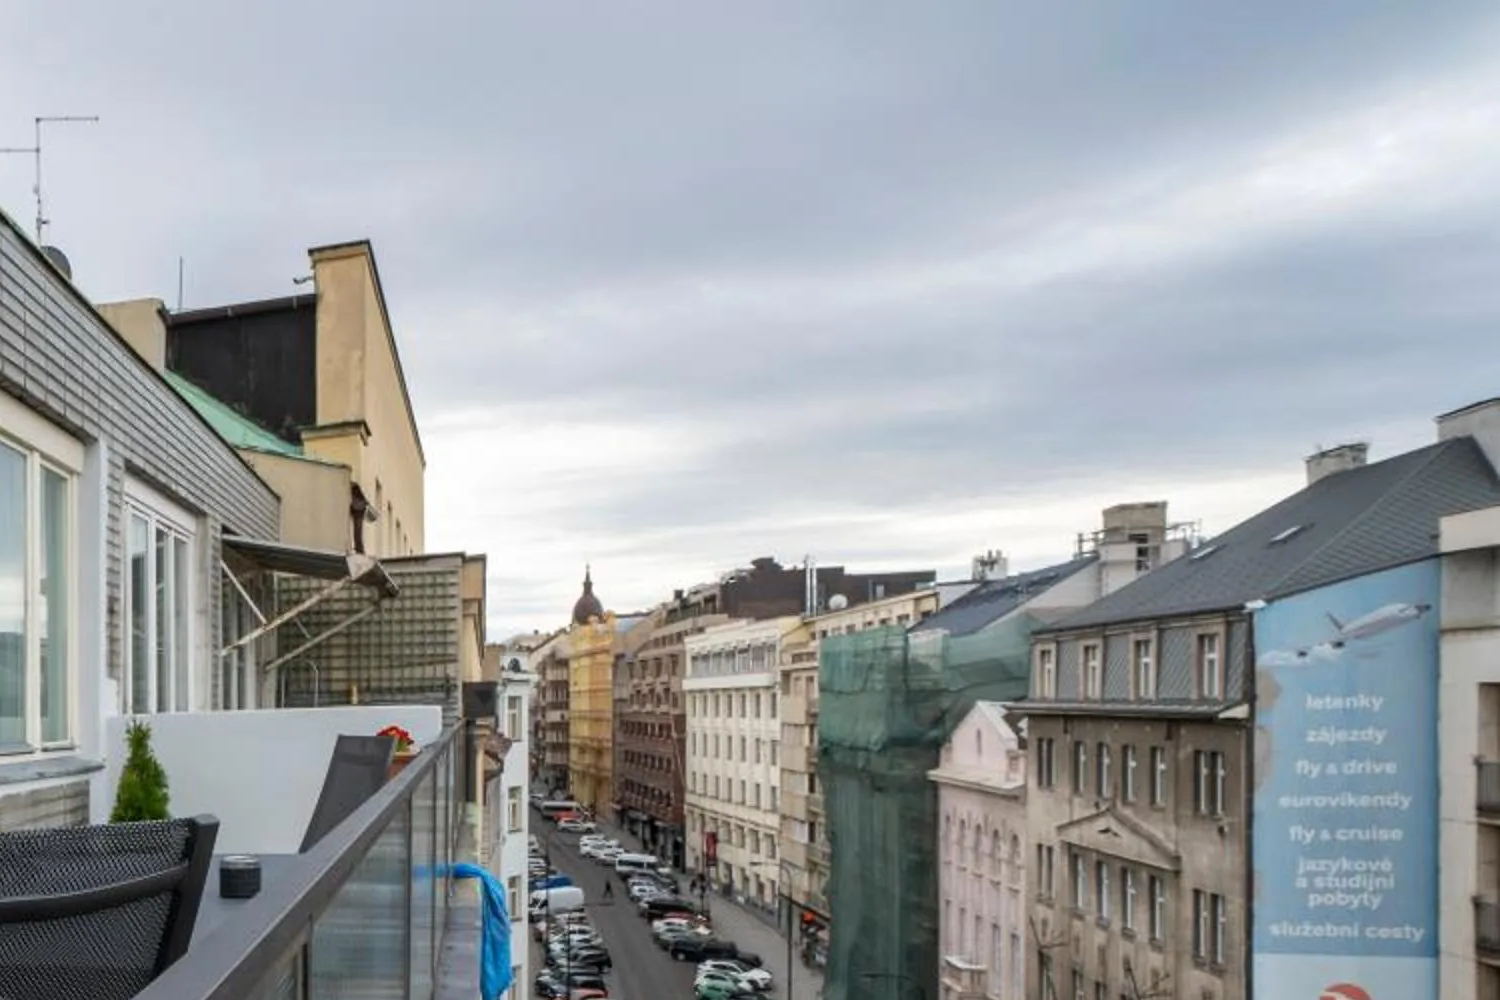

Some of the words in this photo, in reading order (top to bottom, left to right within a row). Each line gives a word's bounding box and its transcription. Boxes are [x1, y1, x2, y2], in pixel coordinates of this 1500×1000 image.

[1305, 693, 1384, 712] letenky
[1306, 726, 1388, 746] zájezdy
[1296, 759, 1322, 779] fly
[1343, 757, 1397, 775] drive
[1289, 825, 1315, 845] fly
[1335, 824, 1404, 841] cruise
[1298, 856, 1393, 875] jazykové
[1296, 876, 1308, 889] a
[1308, 890, 1382, 910] pobyty
[1364, 923, 1425, 943] cesty
